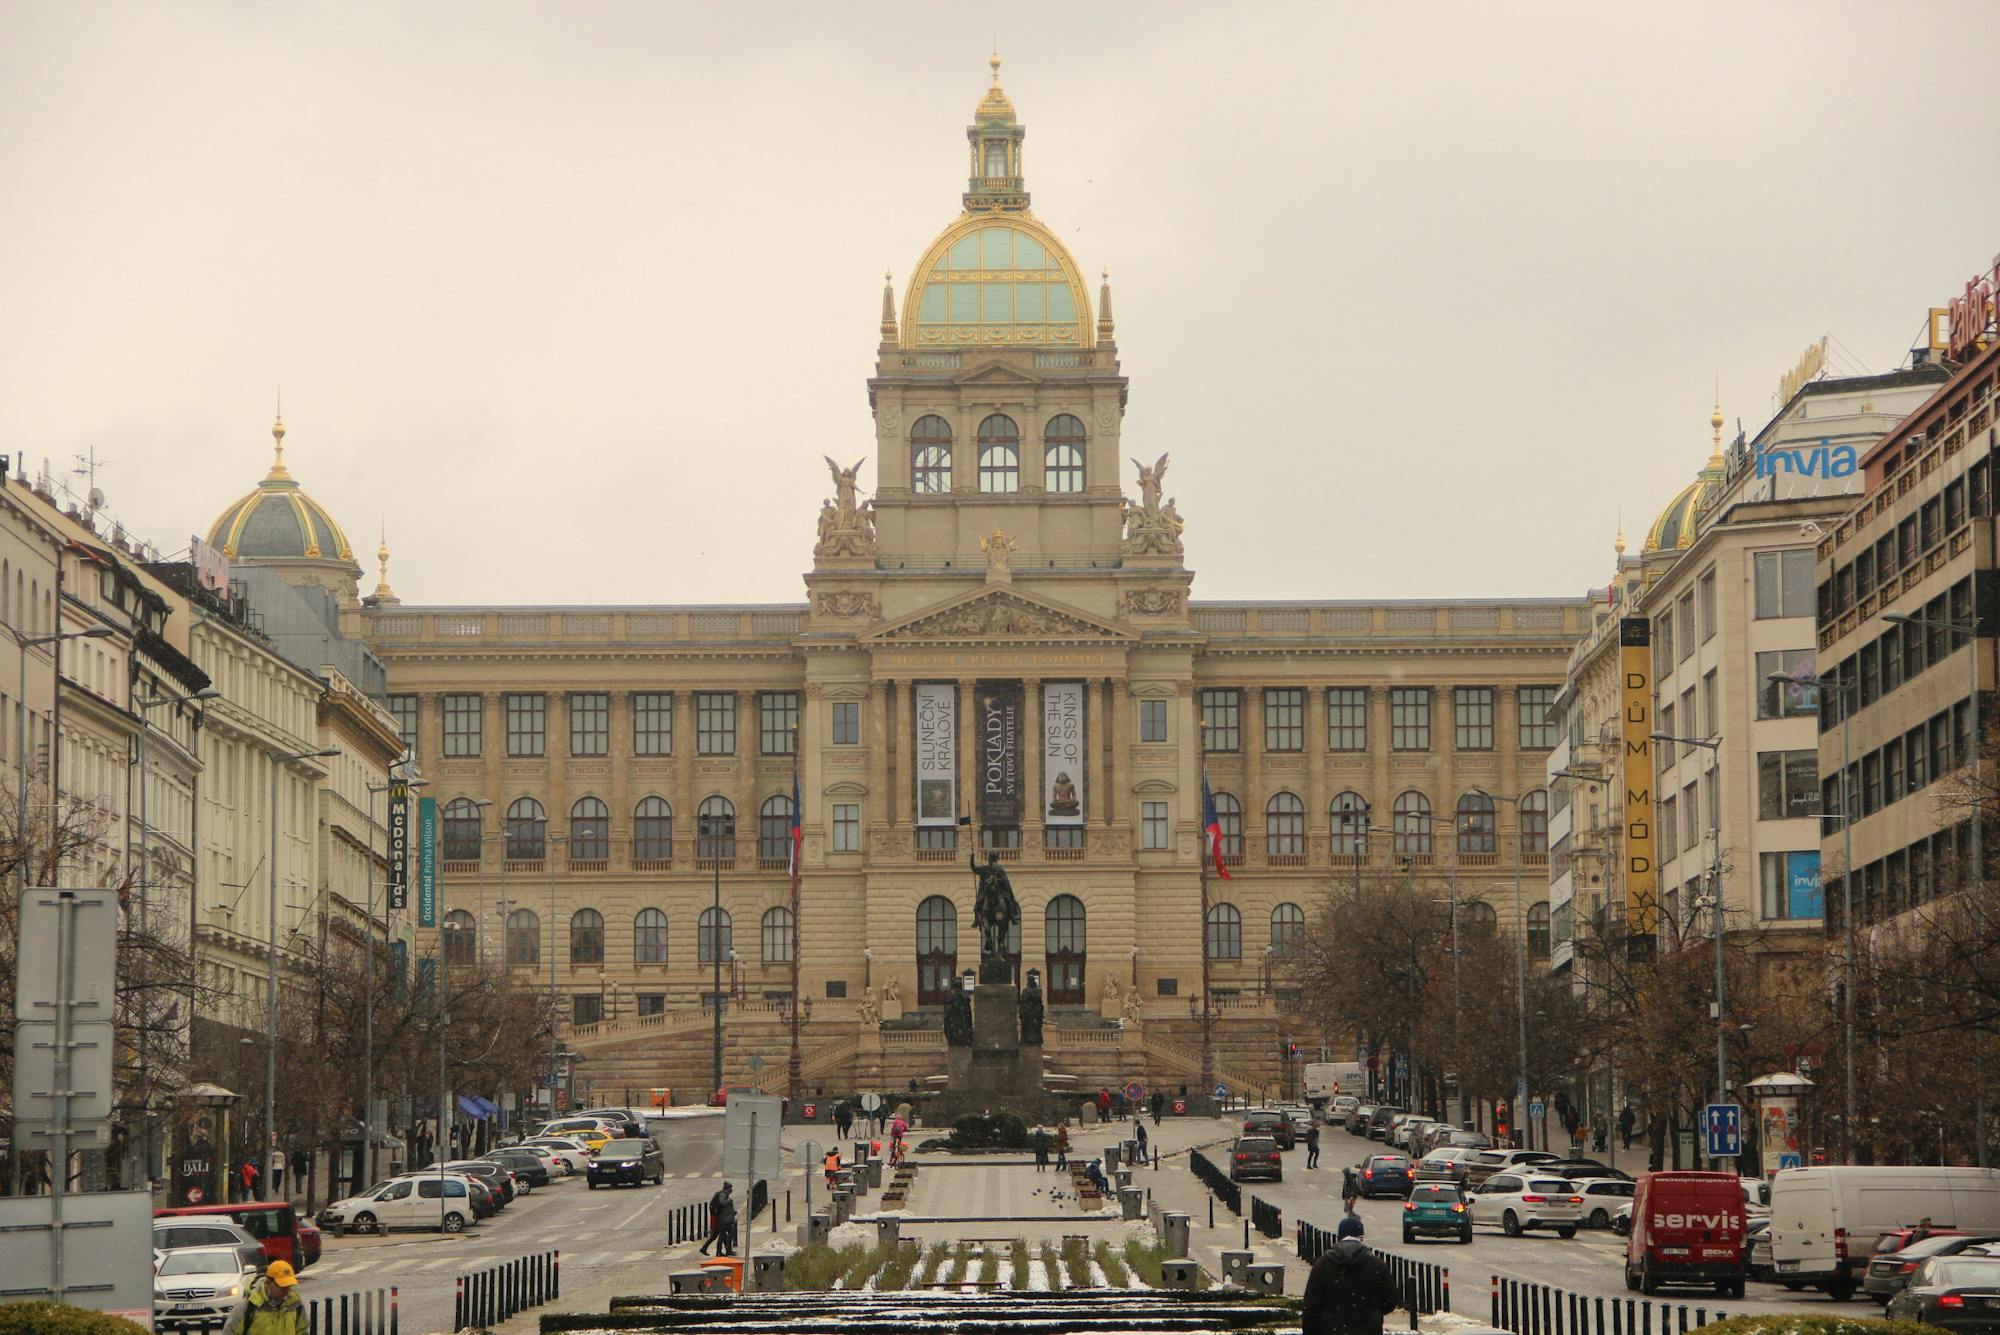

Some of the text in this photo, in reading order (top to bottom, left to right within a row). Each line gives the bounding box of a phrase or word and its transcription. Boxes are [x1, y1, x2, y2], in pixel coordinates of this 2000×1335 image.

[1755, 437, 1857, 480] invia
[919, 692, 935, 770] SLUNEČNÍ
[935, 700, 951, 770] KRÁLOVÉ
[985, 702, 1005, 794] POKLADY
[1047, 691, 1061, 757] THE SUN
[1063, 692, 1078, 765] KINGS OF
[1626, 672, 1648, 757] DŮM
[392, 803, 406, 908] McDonald's
[423, 818, 433, 921] Occidental Praha Wilson
[1654, 1210, 1739, 1230] servis
